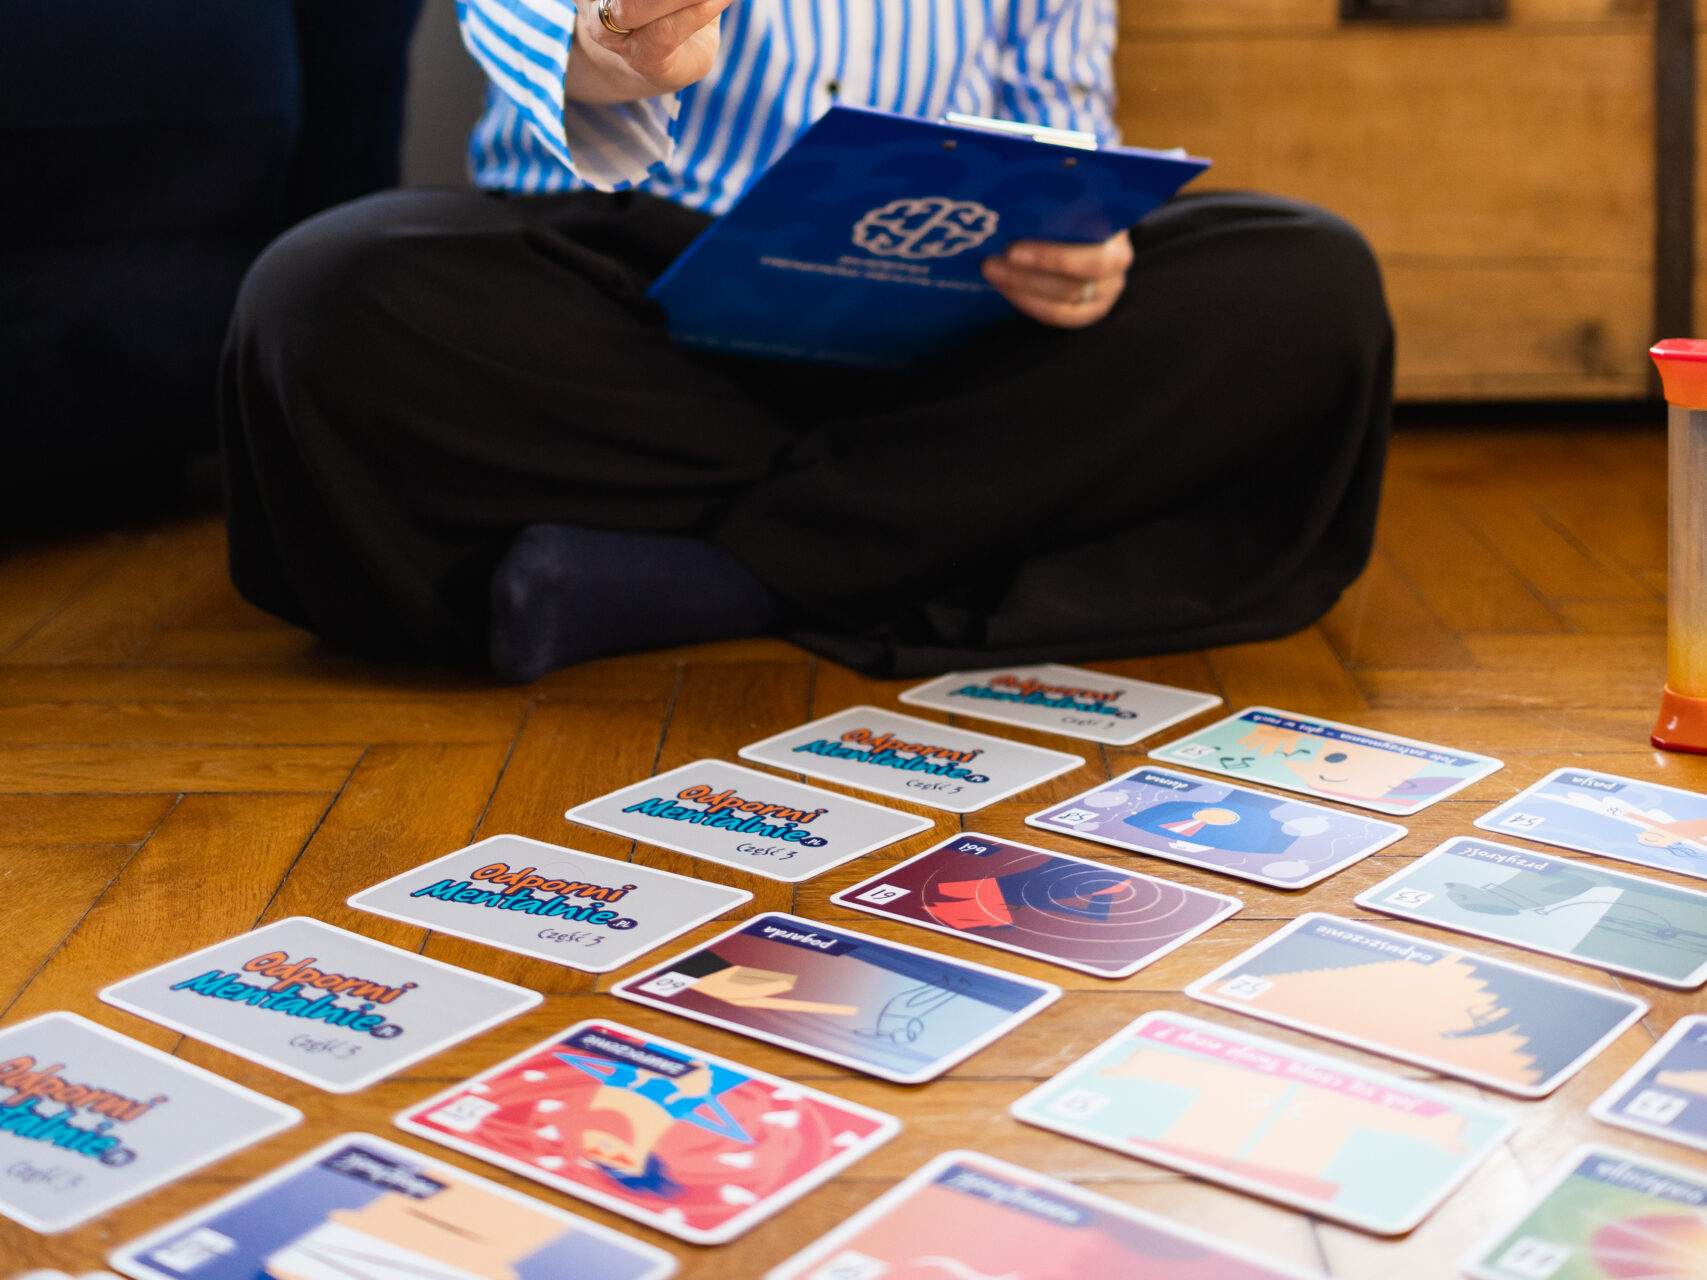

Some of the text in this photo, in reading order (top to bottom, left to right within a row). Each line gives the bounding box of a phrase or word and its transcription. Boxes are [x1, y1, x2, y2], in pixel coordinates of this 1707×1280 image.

[840, 728, 984, 763] Odporni
[1144, 774, 1189, 790] duma
[1571, 776, 1617, 790] pasja
[677, 785, 829, 824] Odporni
[958, 842, 988, 856] ból
[1457, 847, 1549, 871] przykrość
[470, 862, 637, 902] Odporni
[763, 925, 838, 950] pogarda
[1316, 925, 1434, 962] odpuszczenie
[242, 951, 418, 1004] Odporni
